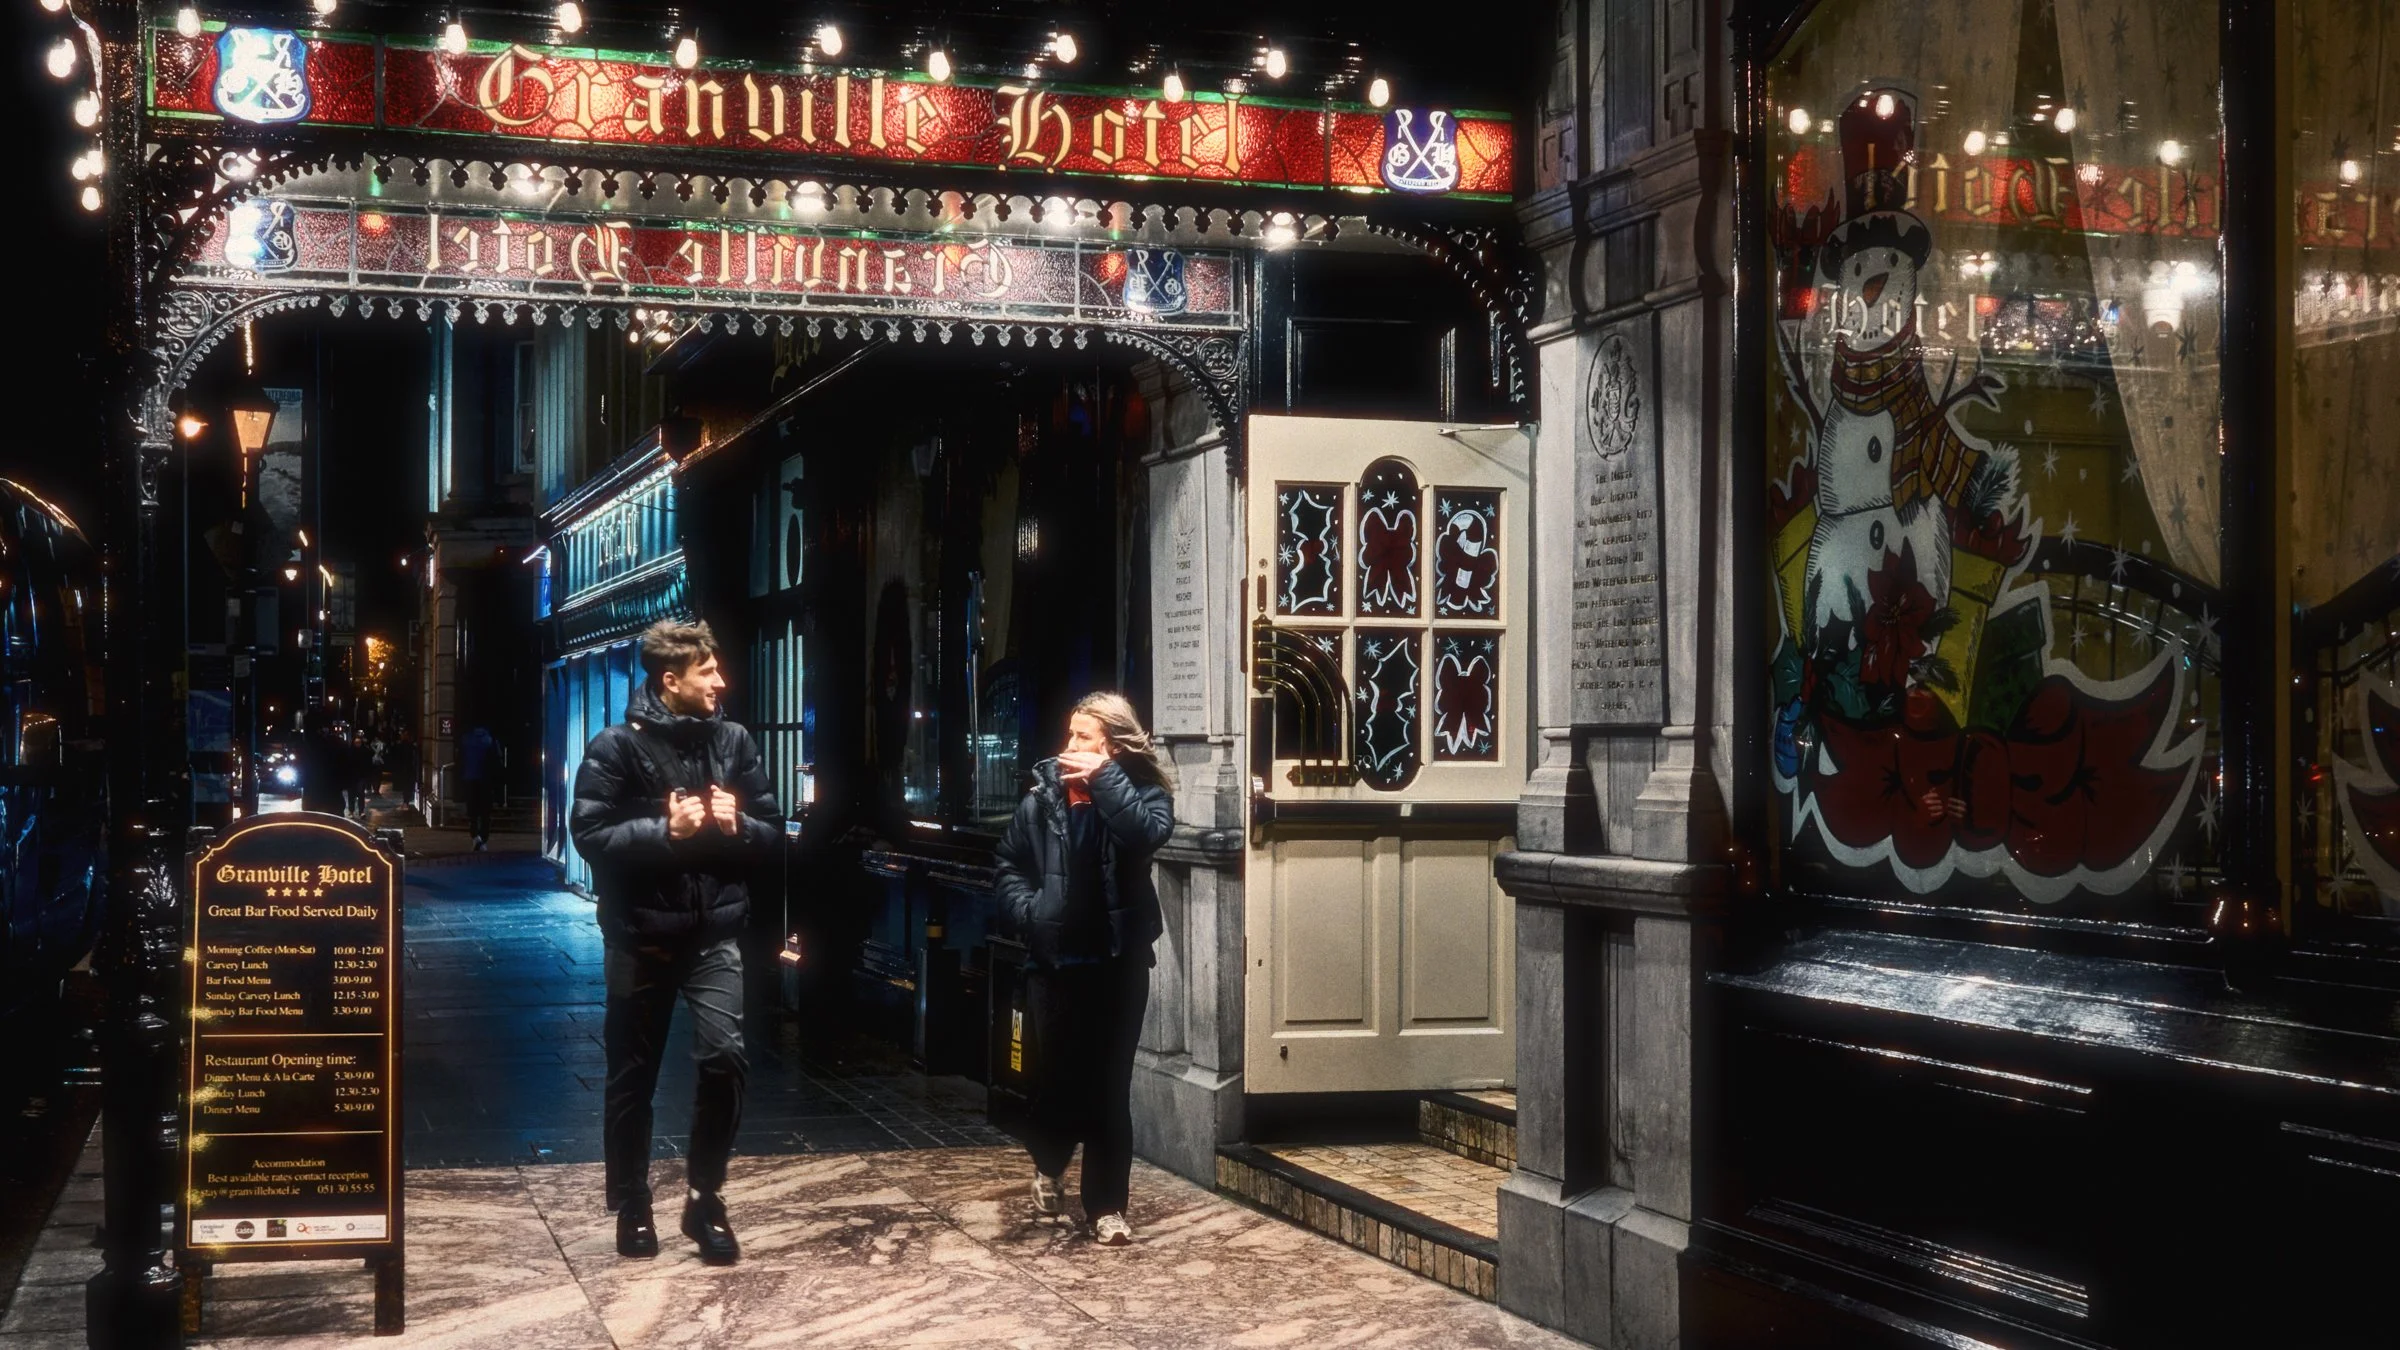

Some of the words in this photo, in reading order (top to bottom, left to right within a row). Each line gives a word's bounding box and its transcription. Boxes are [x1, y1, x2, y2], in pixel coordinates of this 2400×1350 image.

[479, 44, 939, 154] Granville
[996, 85, 1241, 176] Hotel
[216, 864, 310, 883] Granville
[318, 865, 372, 887] Hotel
[208, 905, 241, 917] Great
[245, 905, 265, 917] Bar
[269, 905, 299, 917] Food
[303, 905, 343, 917] Served
[347, 905, 378, 919] Daily
[206, 946, 243, 957] Morning
[244, 945, 273, 954] Coffee
[206, 961, 239, 971] Carvery
[242, 961, 268, 969] Lunch
[334, 961, 377, 969] 12.30-2.30
[206, 976, 221, 985] Bar
[223, 976, 245, 985] Food
[247, 976, 271, 985] Menu
[333, 976, 372, 984] 3.00-9.00
[206, 992, 236, 1002] Sunday
[238, 992, 271, 1002] Carvery
[274, 991, 300, 1000] Lunch
[334, 991, 355, 999] 12.15
[238, 1007, 254, 1015] Bar
[255, 1007, 277, 1015] Food
[279, 1007, 303, 1015] Menu
[332, 1007, 372, 1015] 3.30-9.00
[205, 1054, 268, 1066] Restaurant
[272, 1053, 323, 1068] Opening
[327, 1053, 356, 1065] time:
[204, 1073, 234, 1082] Dinner
[236, 1073, 261, 1081] Menu
[263, 1073, 271, 1081] &
[274, 1073, 280, 1081] A
[283, 1073, 290, 1081] la
[292, 1073, 315, 1081] Carte
[335, 1072, 374, 1080] 5.30-9.00
[205, 1090, 234, 1099] unday
[238, 1089, 265, 1098] Lunch
[335, 1087, 379, 1096] 12.30-2.30
[204, 1105, 233, 1113] Dinner
[235, 1105, 260, 1113] Menu
[335, 1103, 374, 1111] 5.30-9.00
[252, 1158, 325, 1168] Accommodation
[208, 1174, 227, 1182] Best
[230, 1173, 269, 1182] available
[272, 1173, 292, 1181] rates
[295, 1172, 326, 1181] contact
[328, 1171, 368, 1181] reception
[317, 1184, 333, 1194] 051
[337, 1184, 349, 1193] 30
[350, 1184, 362, 1193] 55
[364, 1183, 375, 1193] 55
